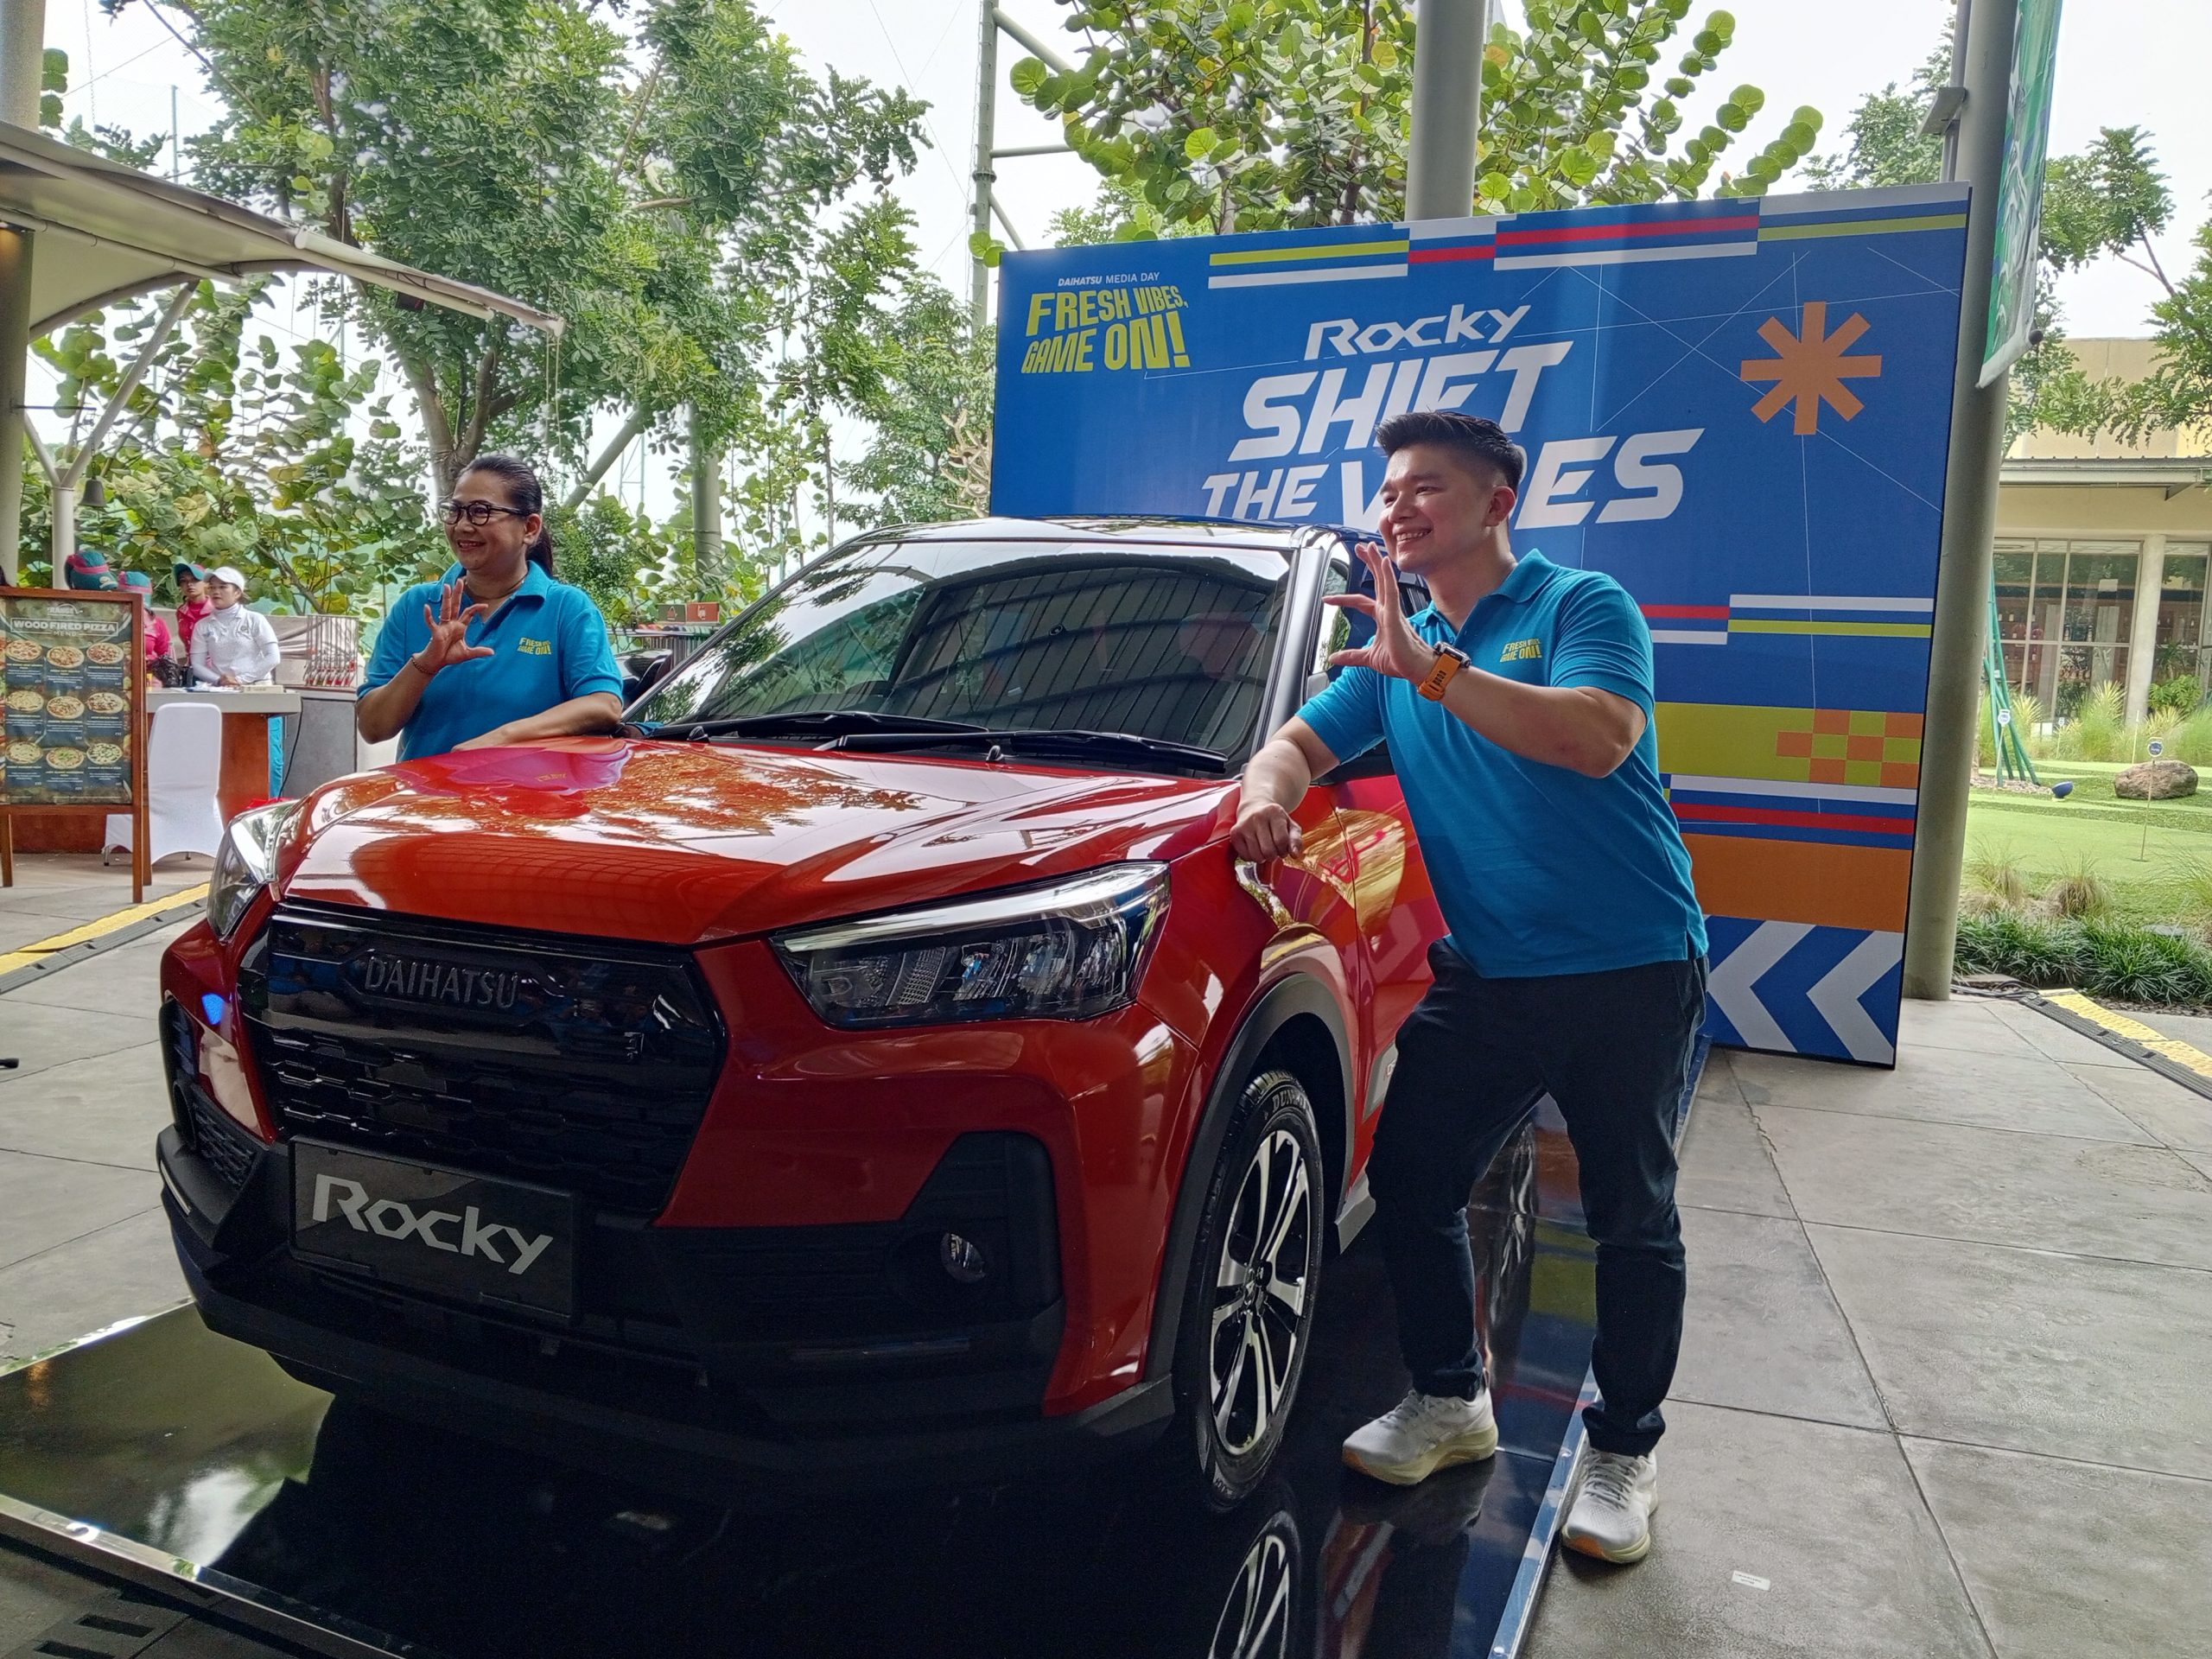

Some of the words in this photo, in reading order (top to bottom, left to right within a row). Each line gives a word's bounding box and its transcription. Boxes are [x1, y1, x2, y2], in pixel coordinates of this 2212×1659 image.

[1058, 276, 1103, 287] DAIHATSU
[1105, 274, 1138, 284] MEDIA
[1141, 271, 1160, 282] DAY
[1026, 288, 1132, 337] FRESH
[1133, 285, 1189, 316] VIBES,
[1020, 328, 1097, 374] GAME
[1104, 311, 1191, 371] ON!
[1228, 340, 1573, 462] SHIFT
[1201, 464, 1328, 520] THE
[13, 620, 49, 630] WOOD
[50, 621, 83, 631] FIRED
[83, 622, 116, 632] PIZZA
[1502, 640, 1528, 654] FRESH
[1519, 645, 1542, 659] ON!
[365, 956, 518, 1008] DAIHATSU
